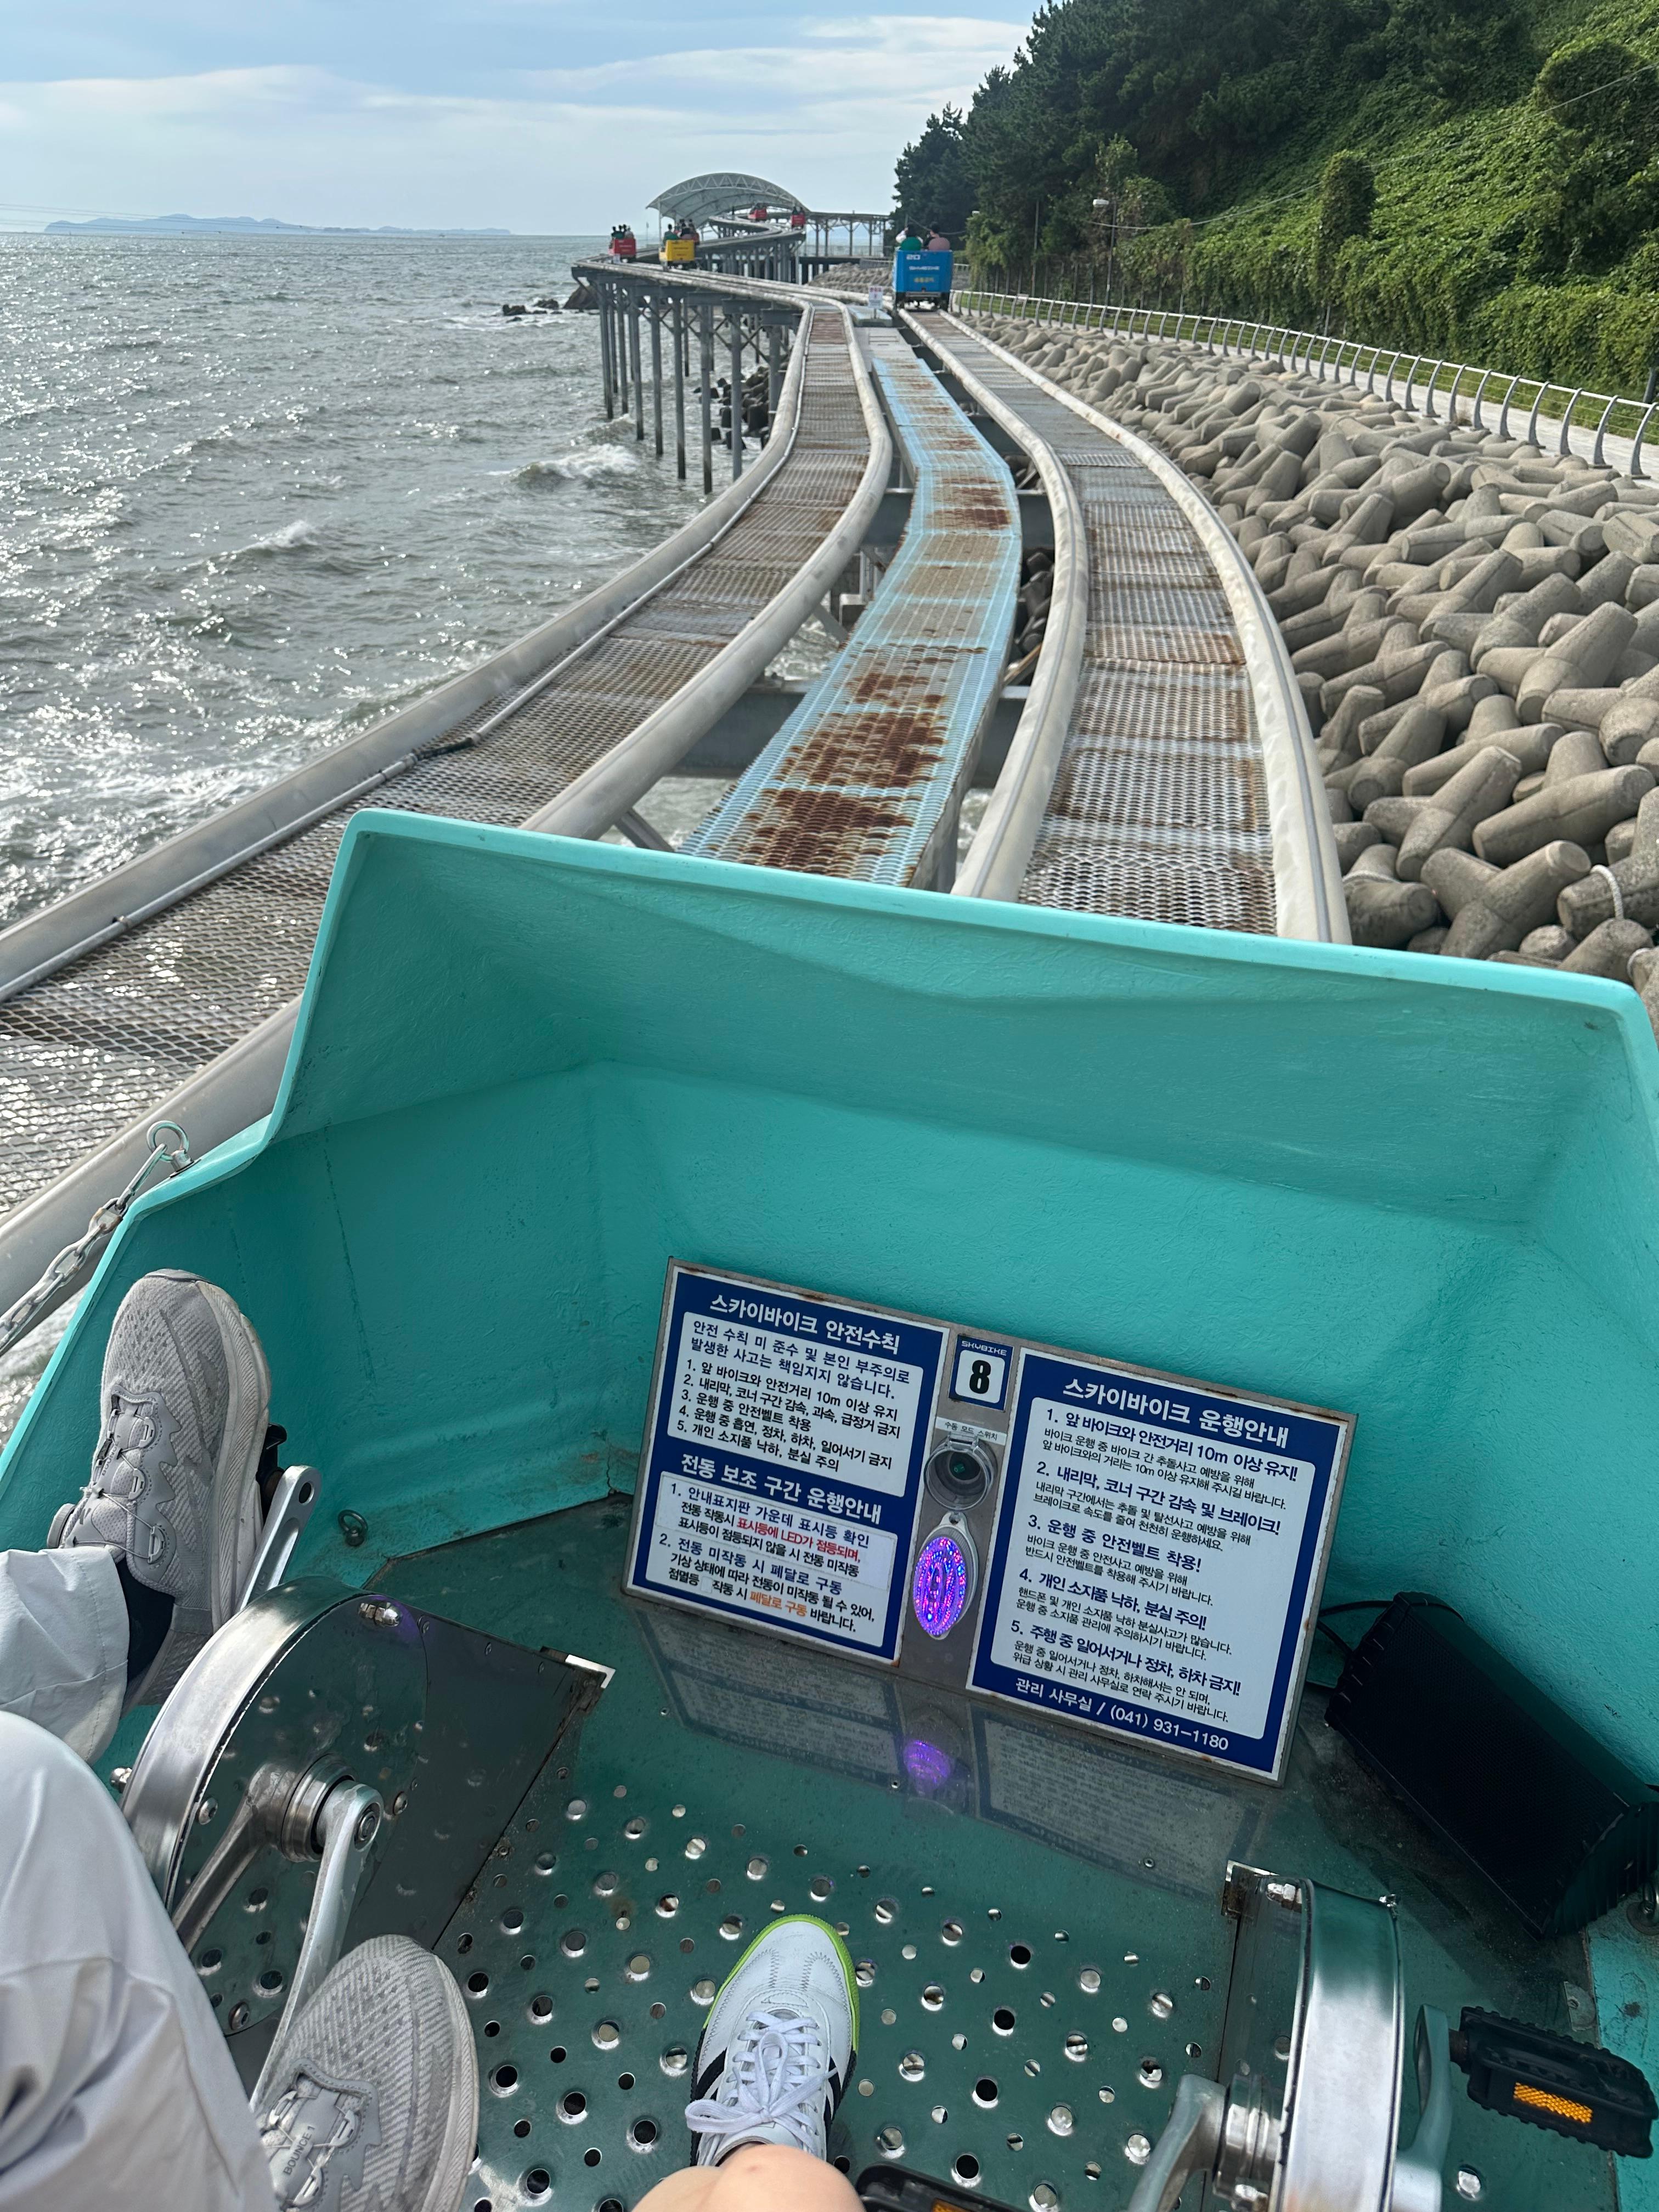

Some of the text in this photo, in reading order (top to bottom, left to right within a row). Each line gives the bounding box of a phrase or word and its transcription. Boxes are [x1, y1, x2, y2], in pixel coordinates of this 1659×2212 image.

[693, 1321, 910, 1384] 안전 수칙 미 준수 및 본인 부주의로
[709, 1294, 900, 1355] 스카이바이크 안전수칙
[961, 1340, 1007, 1356] SKYBIKE
[687, 1358, 898, 1422] 1. 앞 바이크와 안전거리 10m 이상 유지
[691, 1337, 894, 1400] 발생한 사고는 책임지지 않습니다.
[969, 1360, 991, 1394] 8
[679, 1404, 689, 1417] 4.
[693, 1407, 716, 1424] 운행
[718, 1413, 730, 1427] 중
[761, 1425, 786, 1443] 정차,
[791, 1432, 816, 1451] 하차,
[821, 1440, 866, 1463] 일어서기
[868, 1452, 892, 1470] 금지
[681, 1389, 811, 1432] 3. 운행 중 안전벨트 착용
[683, 1373, 900, 1439] 2. 내리막, 코너 구간 감속, 과속, 급정거 금지
[945, 1421, 958, 1431] 수동
[961, 1425, 974, 1434] 모드
[1063, 1378, 1289, 1449] 스카이바이크 운행안내
[676, 1419, 839, 1472] 5. 개인 소지품 낙하, 분실 주의
[1042, 1439, 1286, 1510] 앞 바이크와의 거리는 10m 이상 유지해 주시길 바랍니다.
[1047, 1408, 1298, 1482] 1. 앞 바이크와 안전거리 10m 이상 유지!
[671, 1483, 869, 1549] 1. 안내표지판 가운데 표시등 확인
[681, 1453, 882, 1525] 전동 보조 구간 운행안내
[1036, 1461, 1281, 1536] 2. 내리막, 코너 구간 감속 및 브레이크!
[678, 1516, 859, 1577] 표시등이 점등되지 않을 시 전동 미작동
[681, 1501, 861, 1563] 전동 작동시 표시등에 LED가 점등되며,
[1026, 1534, 1188, 1586] 바이크 운행 중 안전사고 예방을 위해
[1028, 1514, 1201, 1573] 3. 운행 중 안전벨트 착용!
[659, 1533, 842, 1595] 2. 전동 미작동 시 페달로 구동
[670, 1553, 874, 1622] 기상 상태에 따라 전동이 미작동 될 수 있어,
[668, 1567, 856, 1632] 점멸등 작동 시 페달로 구동 바랍니다.
[1019, 1568, 1207, 1631] 4. 개인 소지품 낙하, 분실 주의!
[1011, 1619, 1241, 1696] 5. 주행 중 일어서거나 정차, 하차 금지!
[1015, 1678, 1228, 1750] 관리 사무실 / (041) 931-1180
[283, 2134, 312, 2175] BOUNCE
